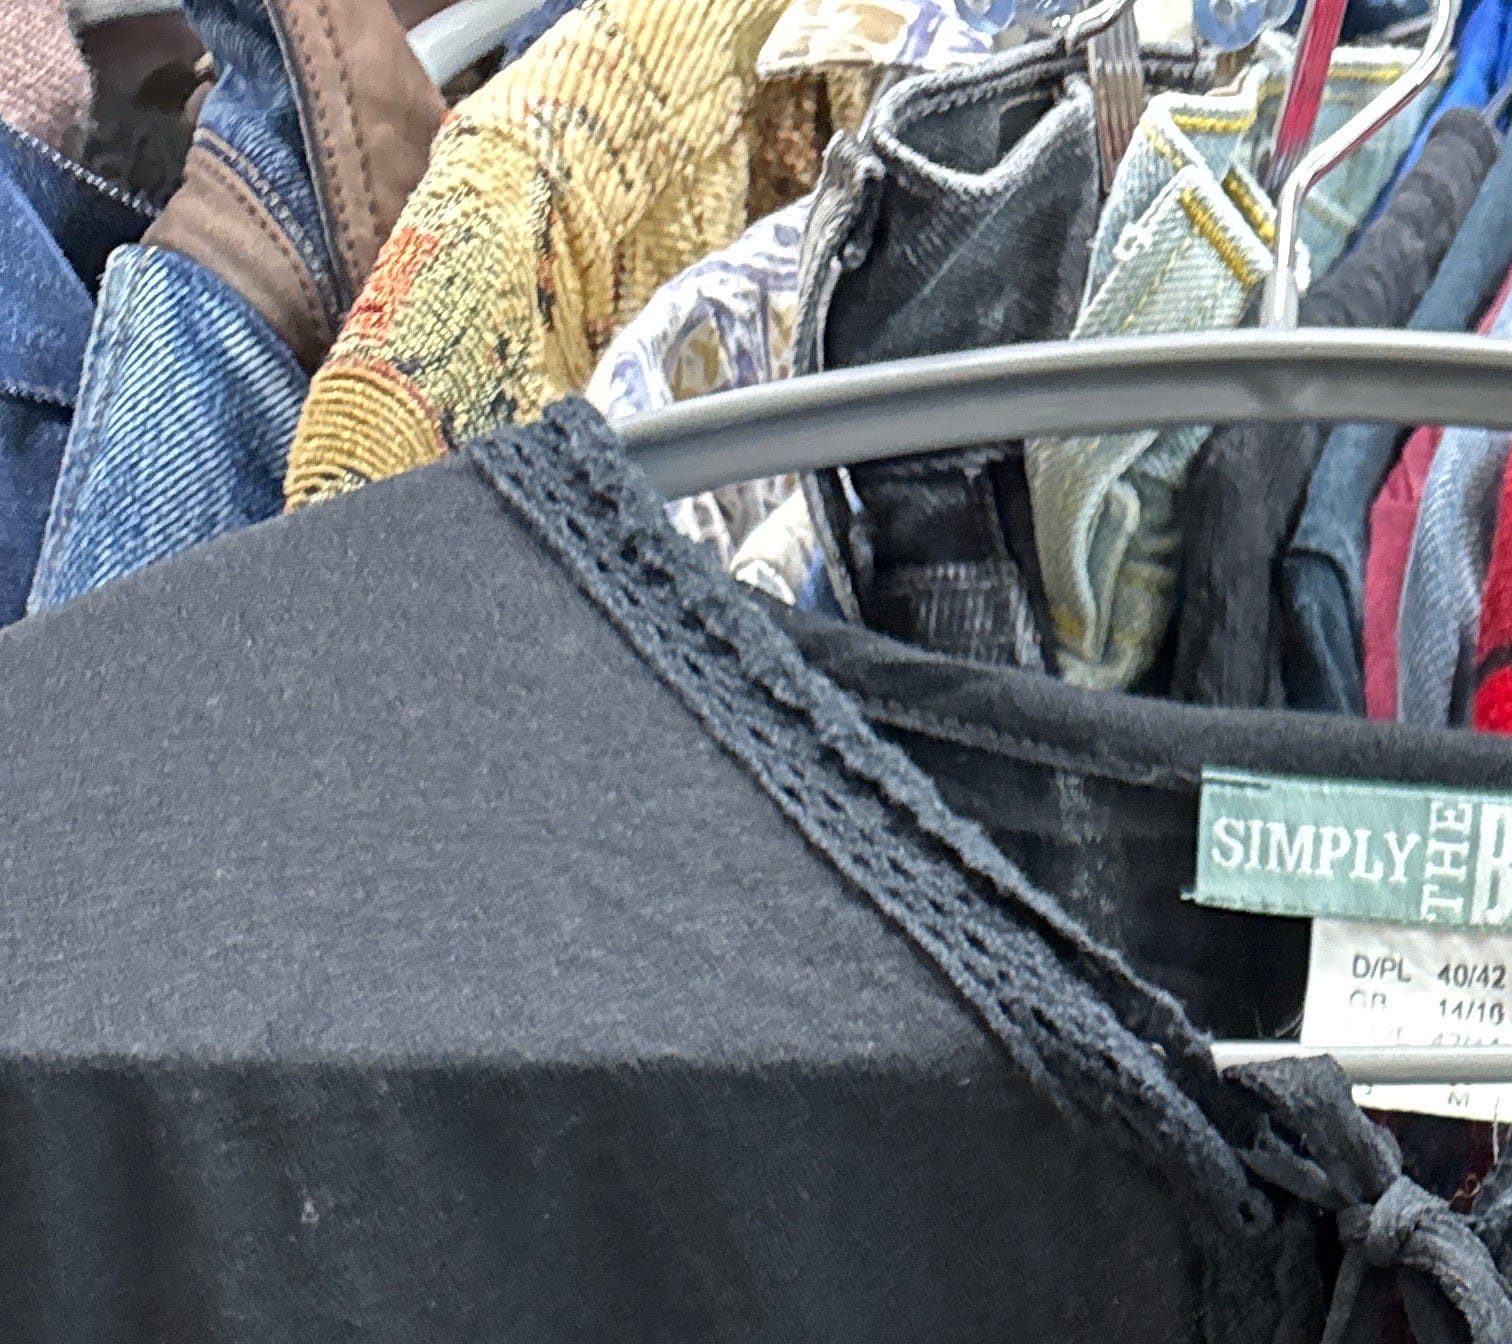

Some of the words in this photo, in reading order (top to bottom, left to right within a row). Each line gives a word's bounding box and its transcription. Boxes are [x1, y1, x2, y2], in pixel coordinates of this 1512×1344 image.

[1211, 815, 1422, 885] SIMPLY
[1420, 801, 1474, 922] THE
[1352, 953, 1413, 984] D/PL
[1436, 962, 1507, 990] 40/42
[1438, 998, 1505, 1026] 14/16
